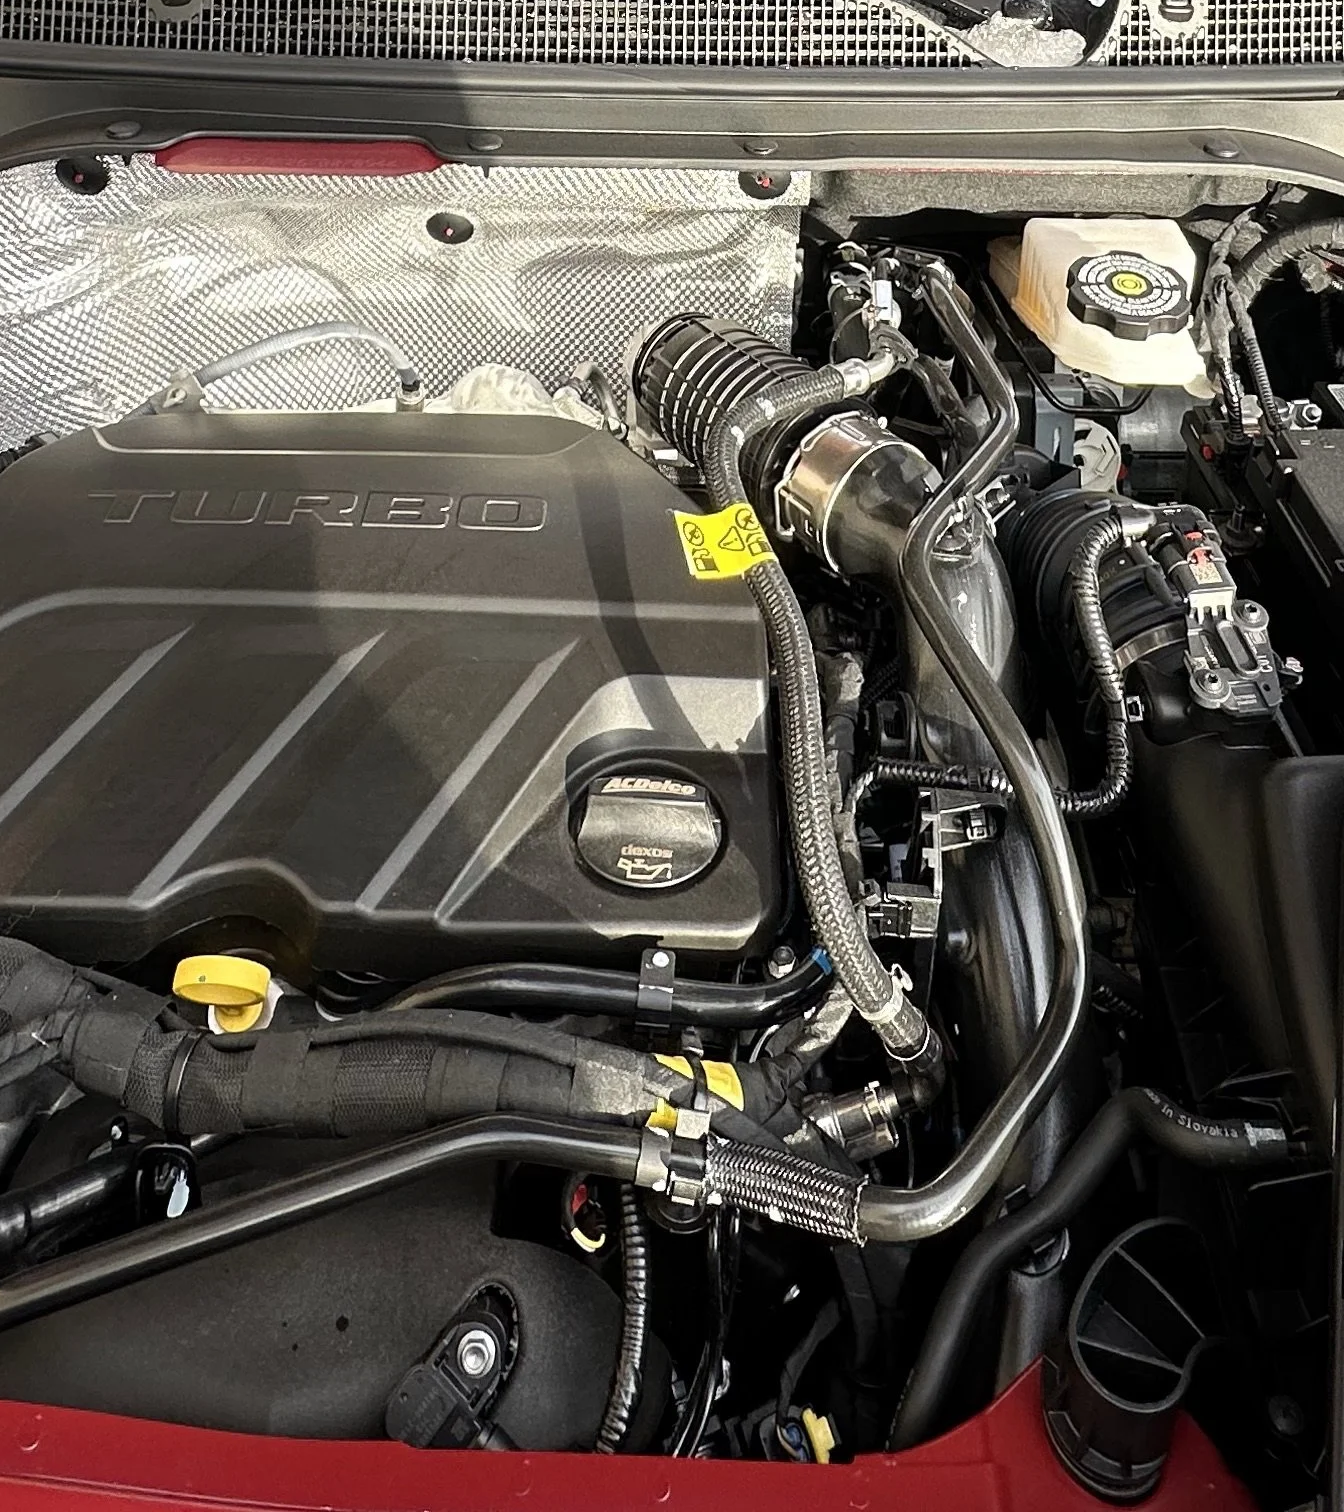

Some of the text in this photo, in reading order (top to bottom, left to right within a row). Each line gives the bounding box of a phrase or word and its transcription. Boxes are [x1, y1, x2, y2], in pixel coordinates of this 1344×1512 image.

[87, 489, 547, 531] TURBO
[601, 778, 696, 795] ACDelco
[621, 844, 674, 858] dexos
[1178, 1114, 1238, 1138] Slovakia
